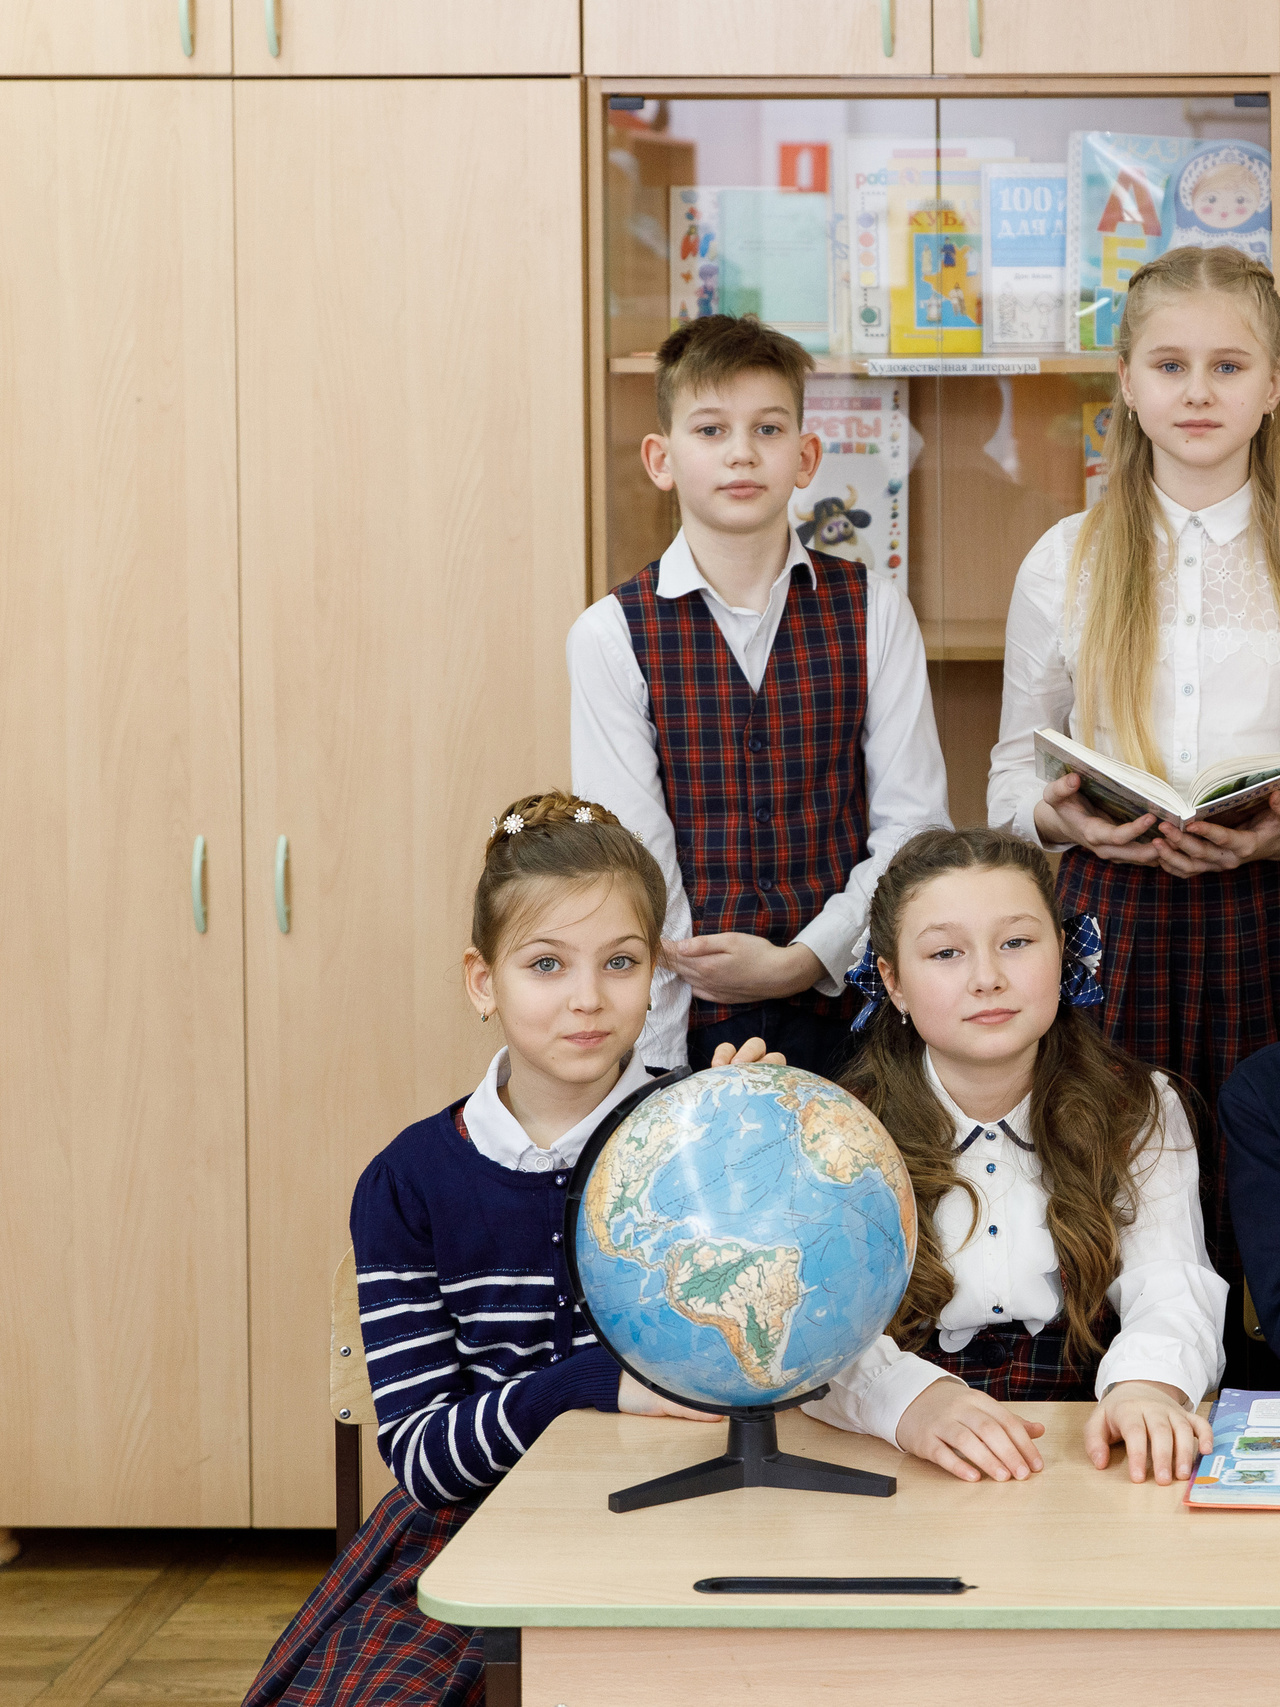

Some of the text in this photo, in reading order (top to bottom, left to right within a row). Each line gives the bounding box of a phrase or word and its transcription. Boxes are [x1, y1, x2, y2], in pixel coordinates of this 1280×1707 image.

[1000, 187, 1053, 212] 100
[998, 219, 1046, 239] ДЛЯ
[869, 361, 1037, 374] Художественная литература
[802, 415, 881, 438] РЕТЫ
